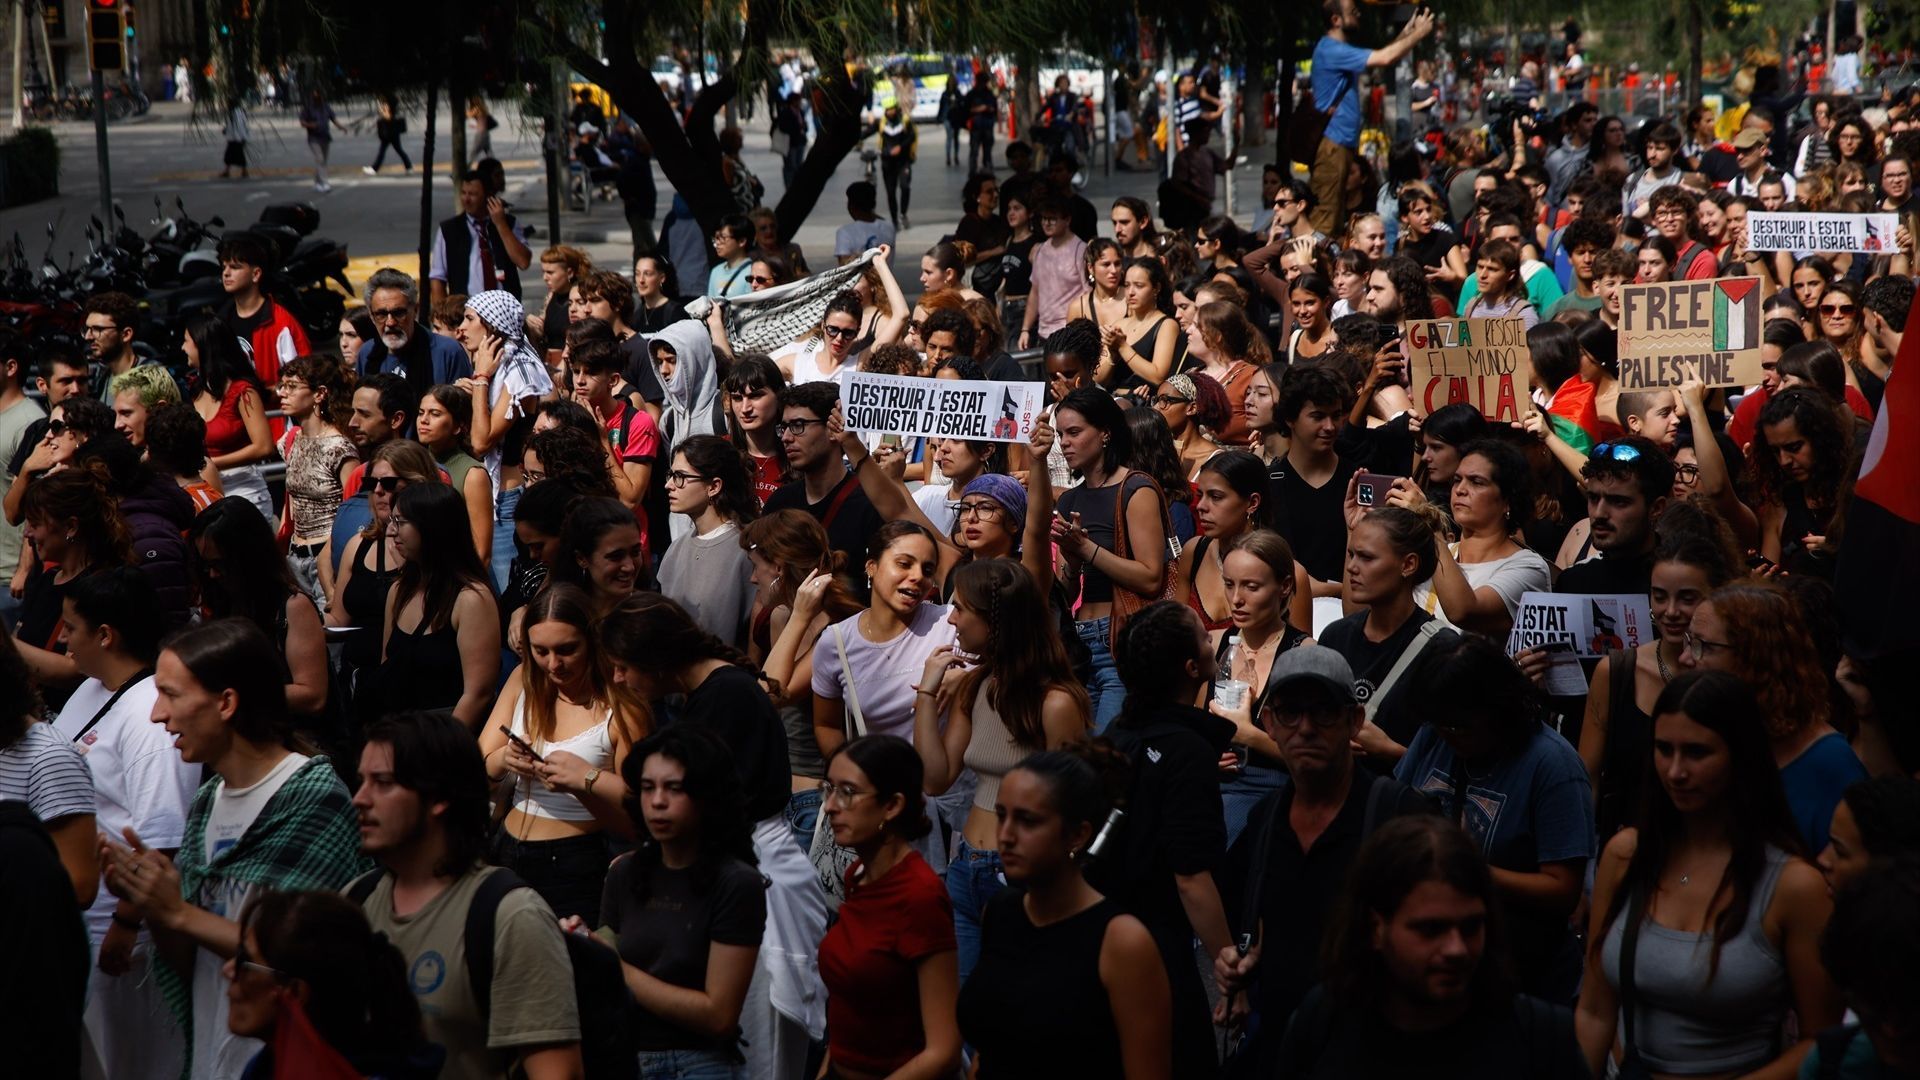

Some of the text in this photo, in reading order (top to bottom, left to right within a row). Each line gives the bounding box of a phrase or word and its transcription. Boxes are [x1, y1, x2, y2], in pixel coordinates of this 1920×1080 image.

[1753, 219, 1852, 236] DESTRUIR L'ESTAT
[1753, 234, 1859, 250] SIONISTA D'ISRAEL
[1624, 283, 1711, 331] FREE
[1410, 318, 1525, 349] GAZA RESISTE
[1427, 347, 1517, 377] EL MUNDO
[1621, 352, 1735, 389] PALESTINE
[851, 375, 905, 386] PALESTINA
[910, 380, 944, 389] LLIURE
[848, 382, 987, 414] DESTRUIR L'ESTAT
[847, 406, 987, 437] SIONISTA D'ISRAEL
